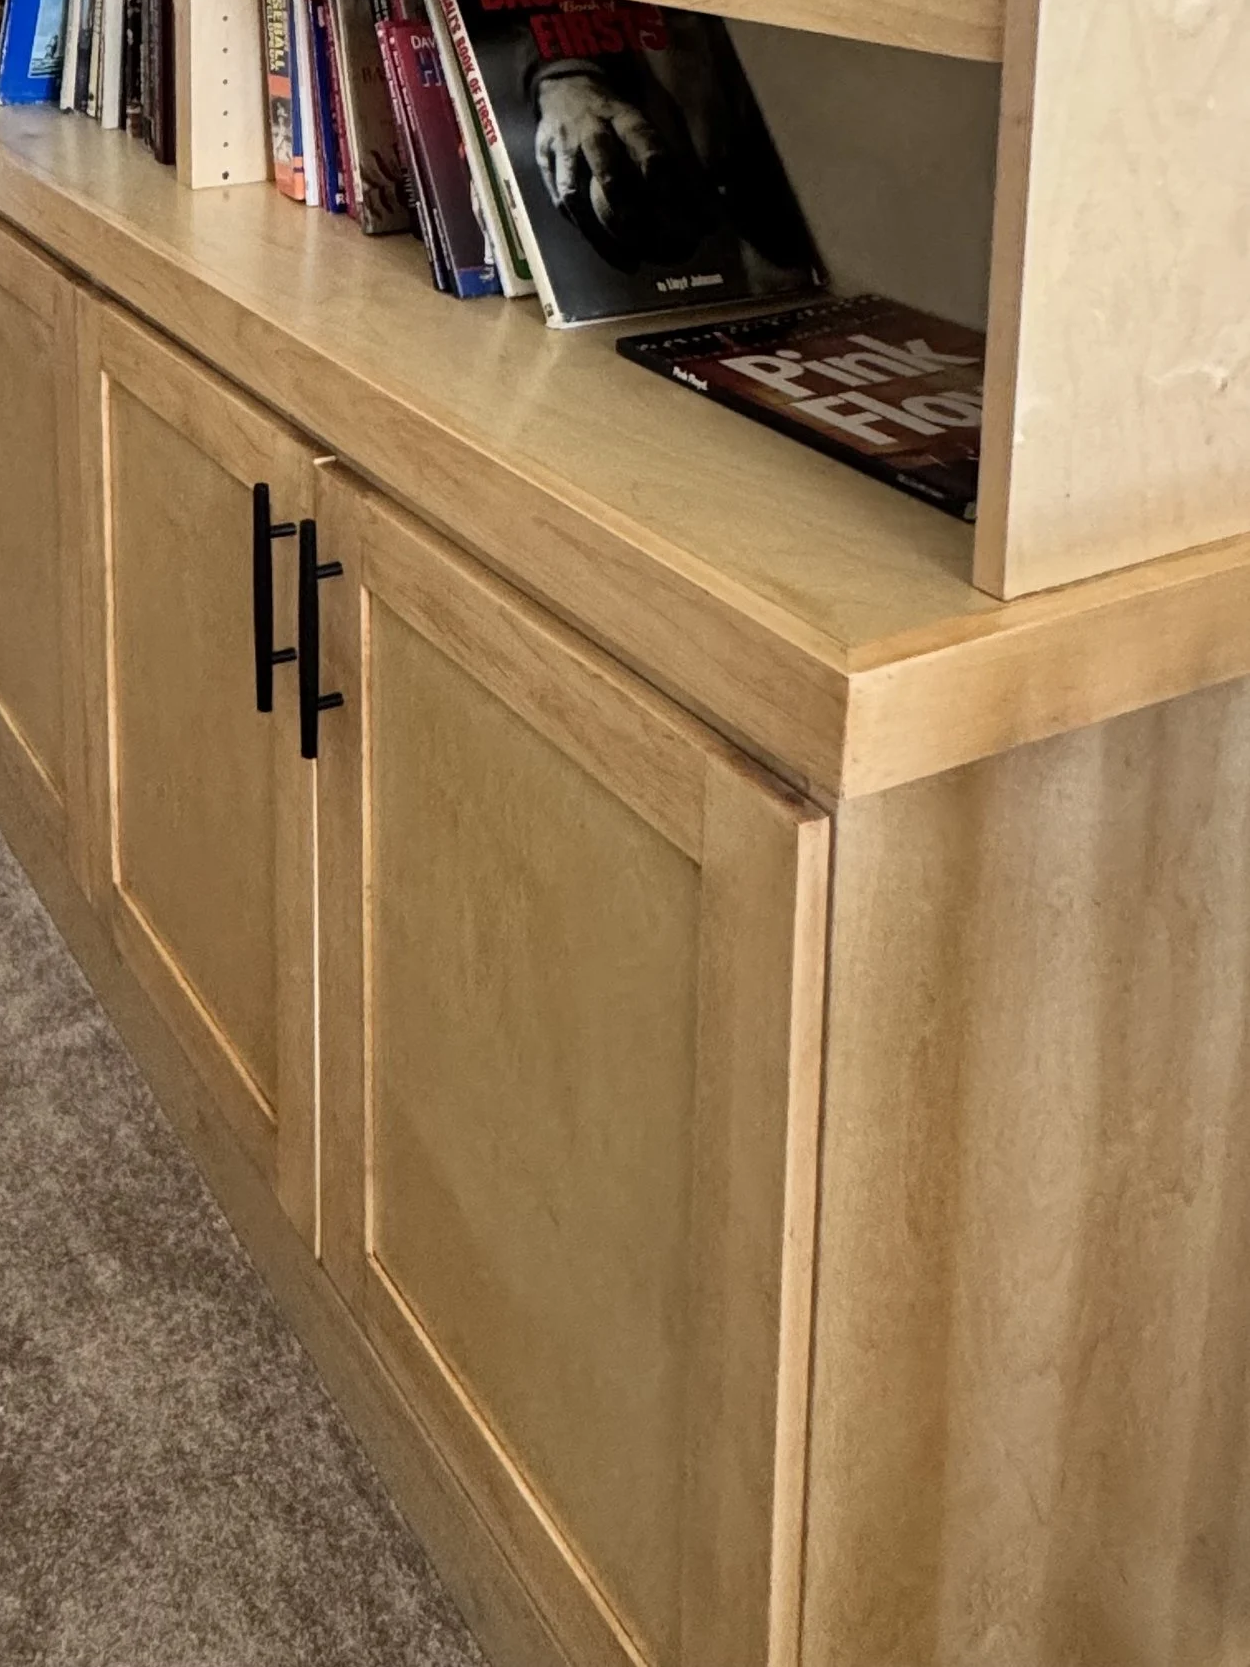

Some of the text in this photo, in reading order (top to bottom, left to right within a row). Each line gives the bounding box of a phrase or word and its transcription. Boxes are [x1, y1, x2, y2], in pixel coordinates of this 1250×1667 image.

[455, 36, 475, 82] BOOK
[530, 5, 668, 62] FIRSTS
[469, 77, 482, 96] OF
[475, 96, 498, 147] FIRSTS
[717, 334, 981, 399] Pink
